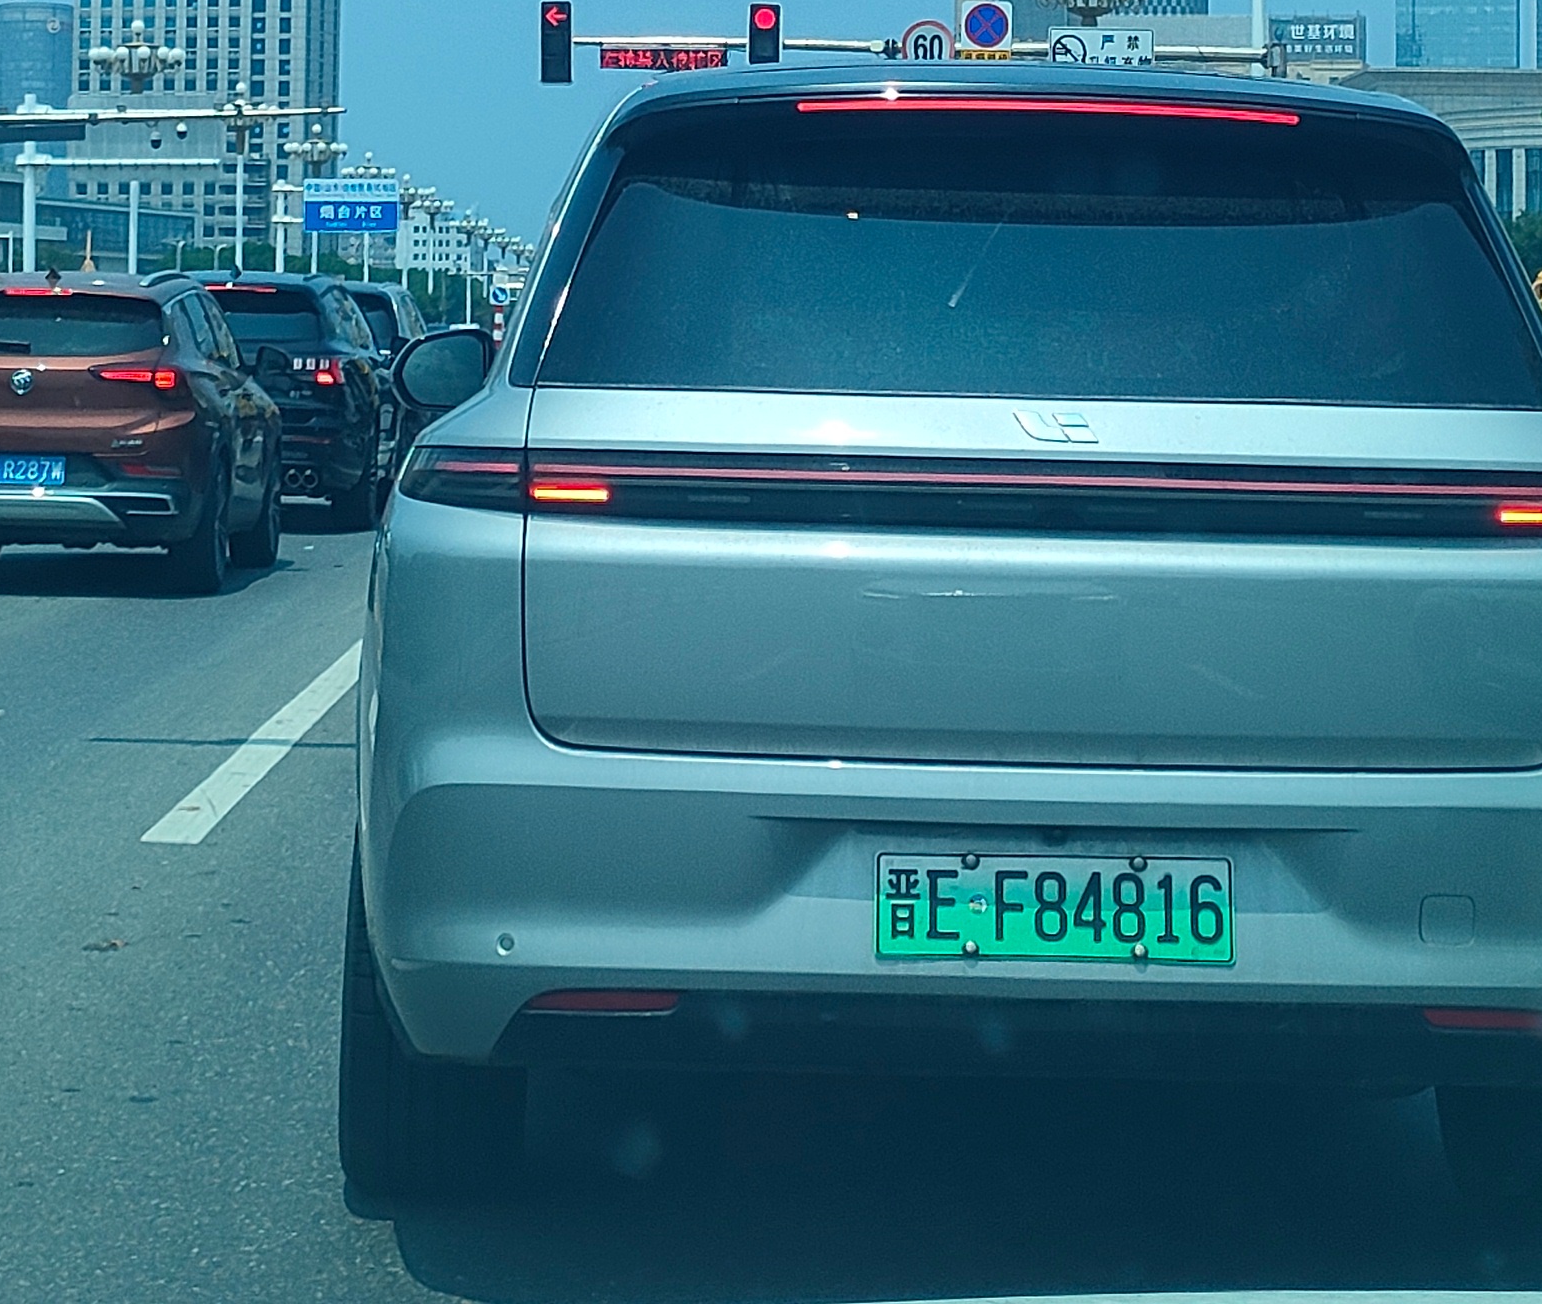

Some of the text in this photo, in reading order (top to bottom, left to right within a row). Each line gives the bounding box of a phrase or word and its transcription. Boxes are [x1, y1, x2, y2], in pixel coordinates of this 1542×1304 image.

[1290, 24, 1355, 40] 世基环境
[914, 34, 943, 60] 60
[1101, 34, 1140, 51] 严禁
[319, 204, 382, 220] 烟台片区
